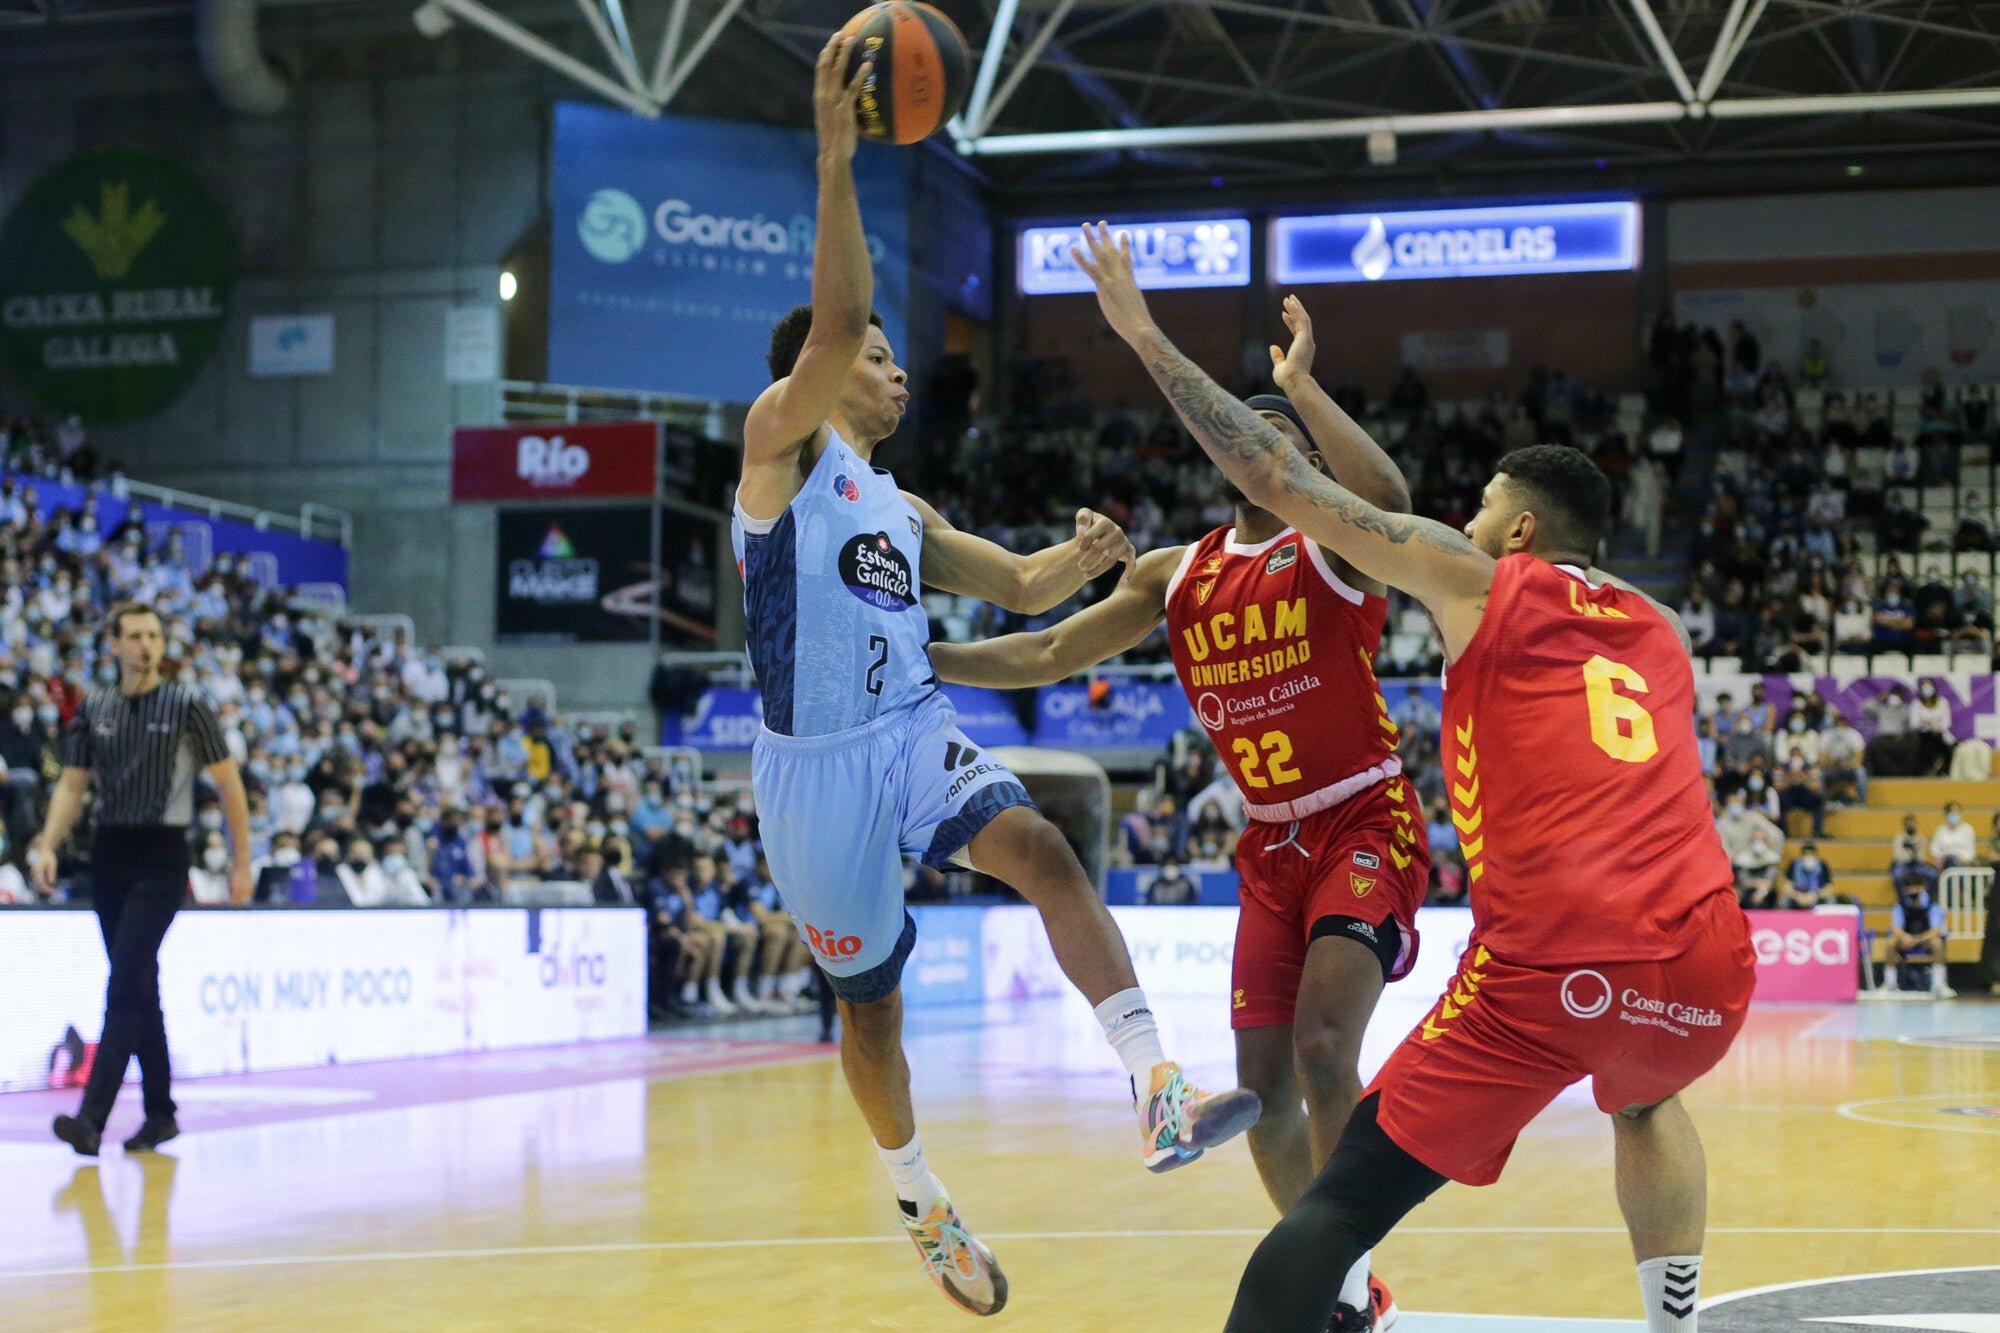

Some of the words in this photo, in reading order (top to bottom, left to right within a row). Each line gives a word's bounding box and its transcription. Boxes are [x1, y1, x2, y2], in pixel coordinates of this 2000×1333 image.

[1394, 225, 1557, 267] CANDELAS
[516, 435, 590, 479] Río
[855, 543, 907, 584] Estrella
[857, 563, 909, 597] Galicia
[1182, 597, 1307, 662] UCAM
[866, 633, 889, 697] 2
[1190, 639, 1312, 687] UNIVERSIDAD
[1226, 694, 1267, 714] Costa
[1269, 674, 1322, 703] Cálida
[1230, 714, 1256, 727] Región
[1256, 710, 1267, 720] de
[1267, 702, 1296, 717] Murcia
[1582, 653, 1659, 763] 6
[1231, 730, 1303, 789] 22
[1355, 857, 1374, 867] acb
[1346, 923, 1379, 944] adidas
[200, 972, 262, 1014] CON
[271, 968, 333, 1011] MUY
[341, 967, 413, 1006] POCO
[1667, 1002, 1723, 1027] Cálida
